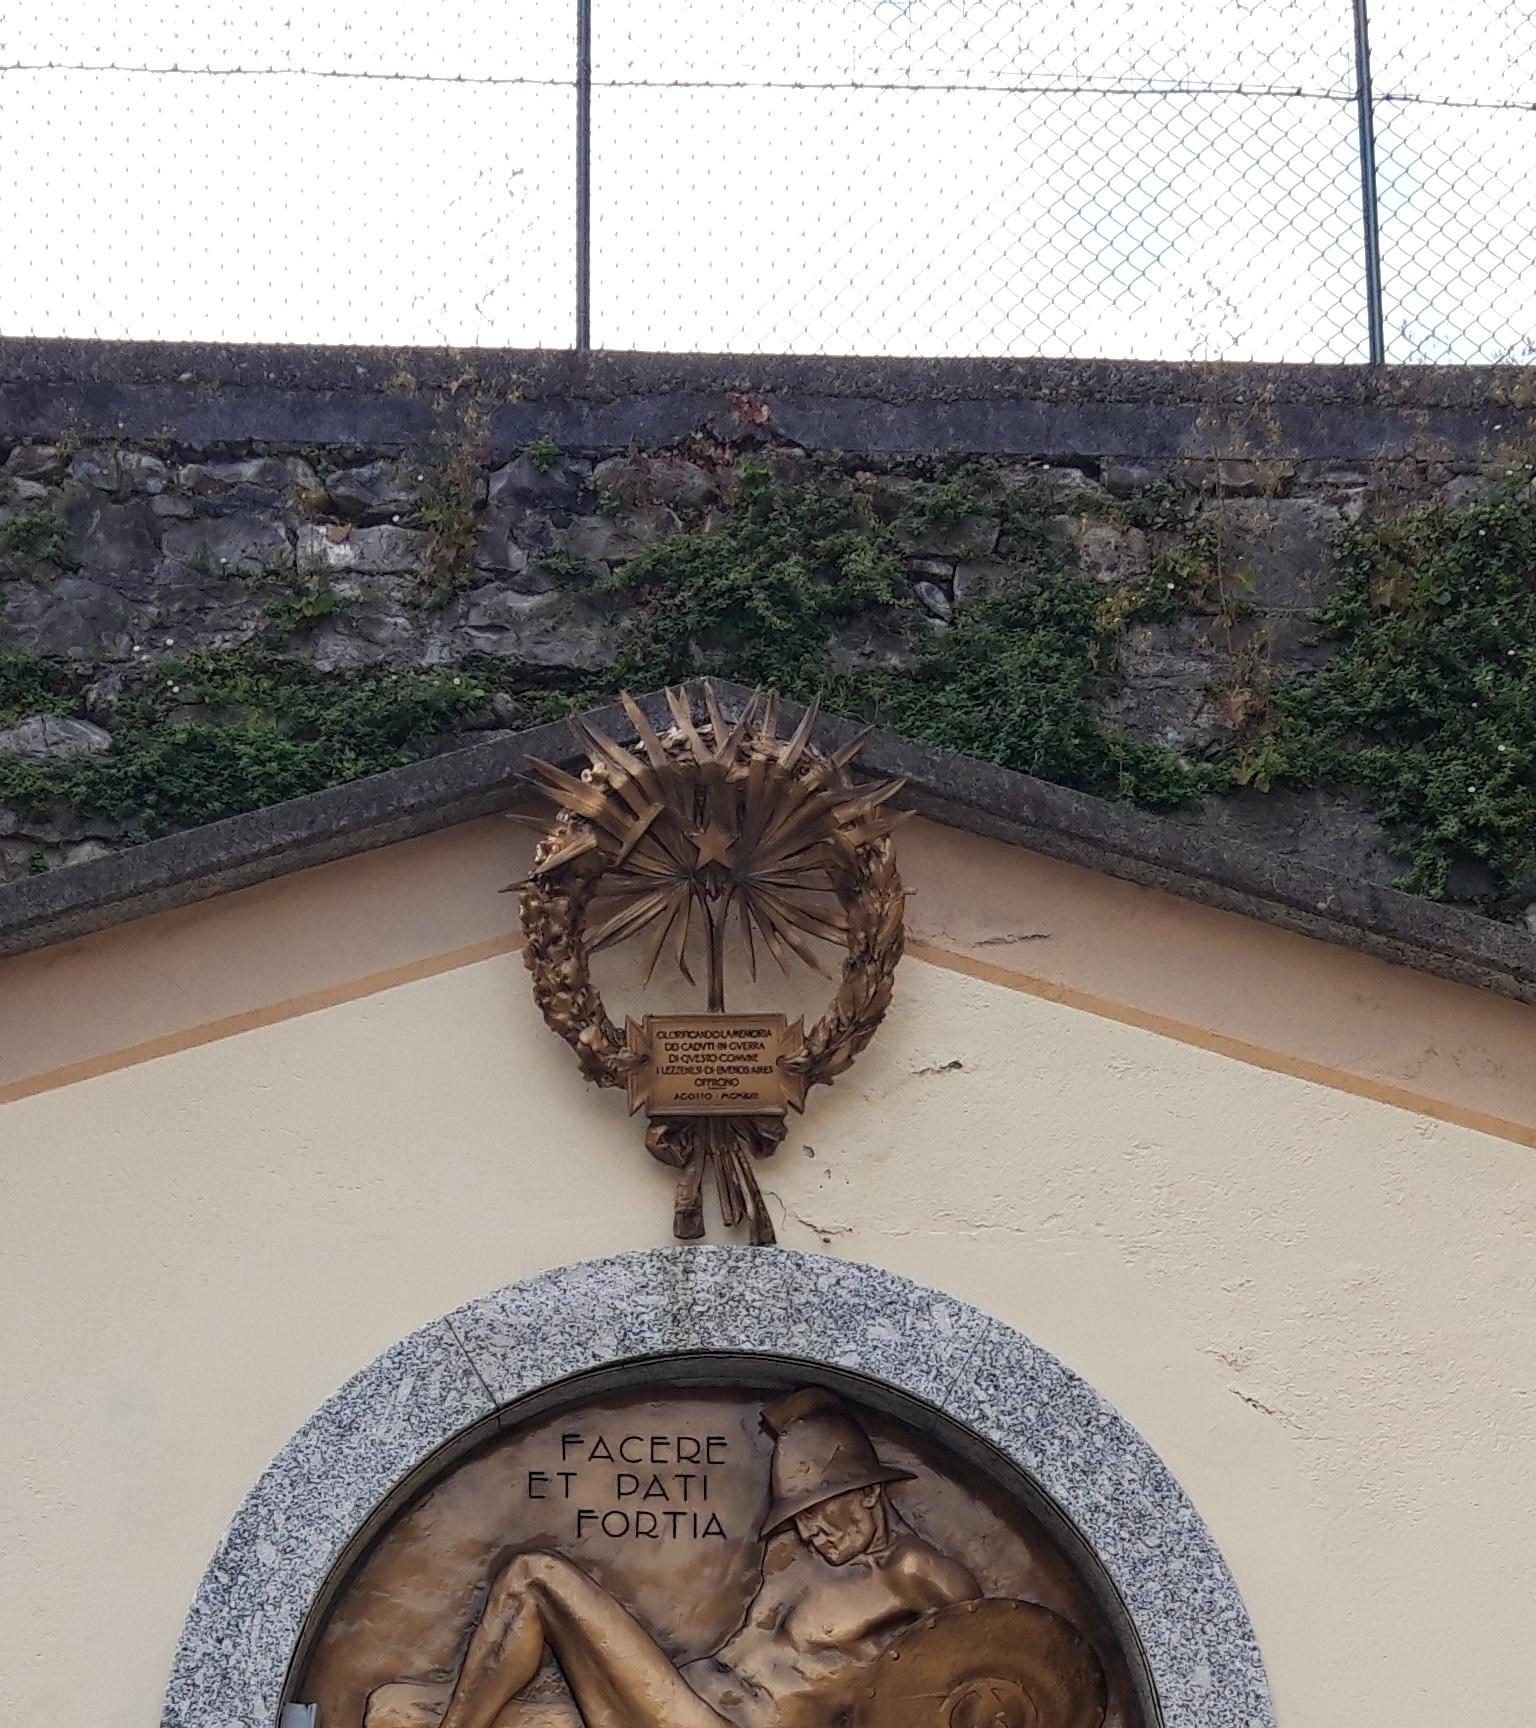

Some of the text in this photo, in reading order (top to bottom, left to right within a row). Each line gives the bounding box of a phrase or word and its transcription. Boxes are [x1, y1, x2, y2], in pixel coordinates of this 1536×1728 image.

[562, 1434, 728, 1465] FACERE
[529, 1472, 709, 1501] ET PATI
[577, 1509, 727, 1539] FORTIA
